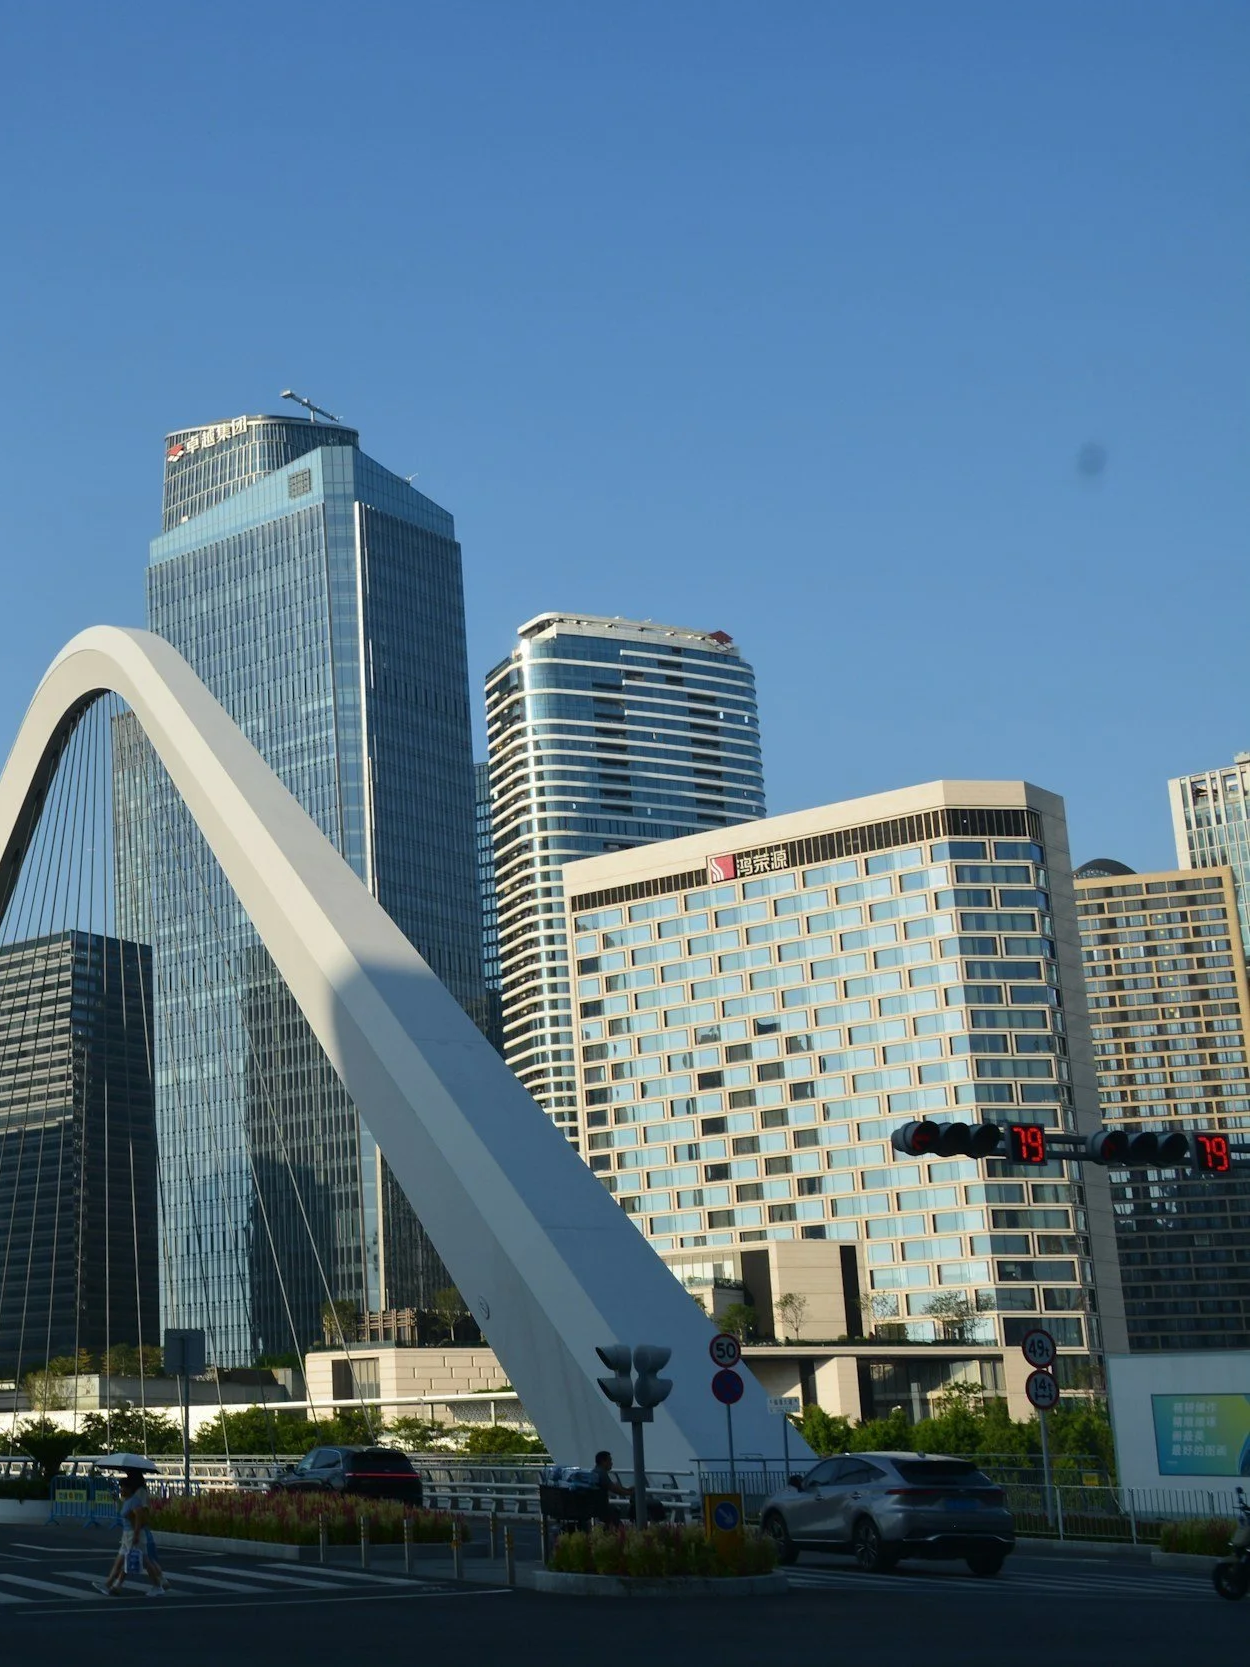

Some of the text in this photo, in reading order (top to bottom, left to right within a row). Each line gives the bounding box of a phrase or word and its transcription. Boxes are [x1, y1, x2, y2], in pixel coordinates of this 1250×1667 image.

[185, 415, 248, 454] 卓越集团
[736, 849, 789, 878] 鸿荣源
[1013, 1126, 1044, 1162] 79
[1198, 1136, 1229, 1172] 79
[716, 1342, 736, 1359] 50
[1028, 1339, 1049, 1358] 49t
[1034, 1377, 1052, 1392] 14t
